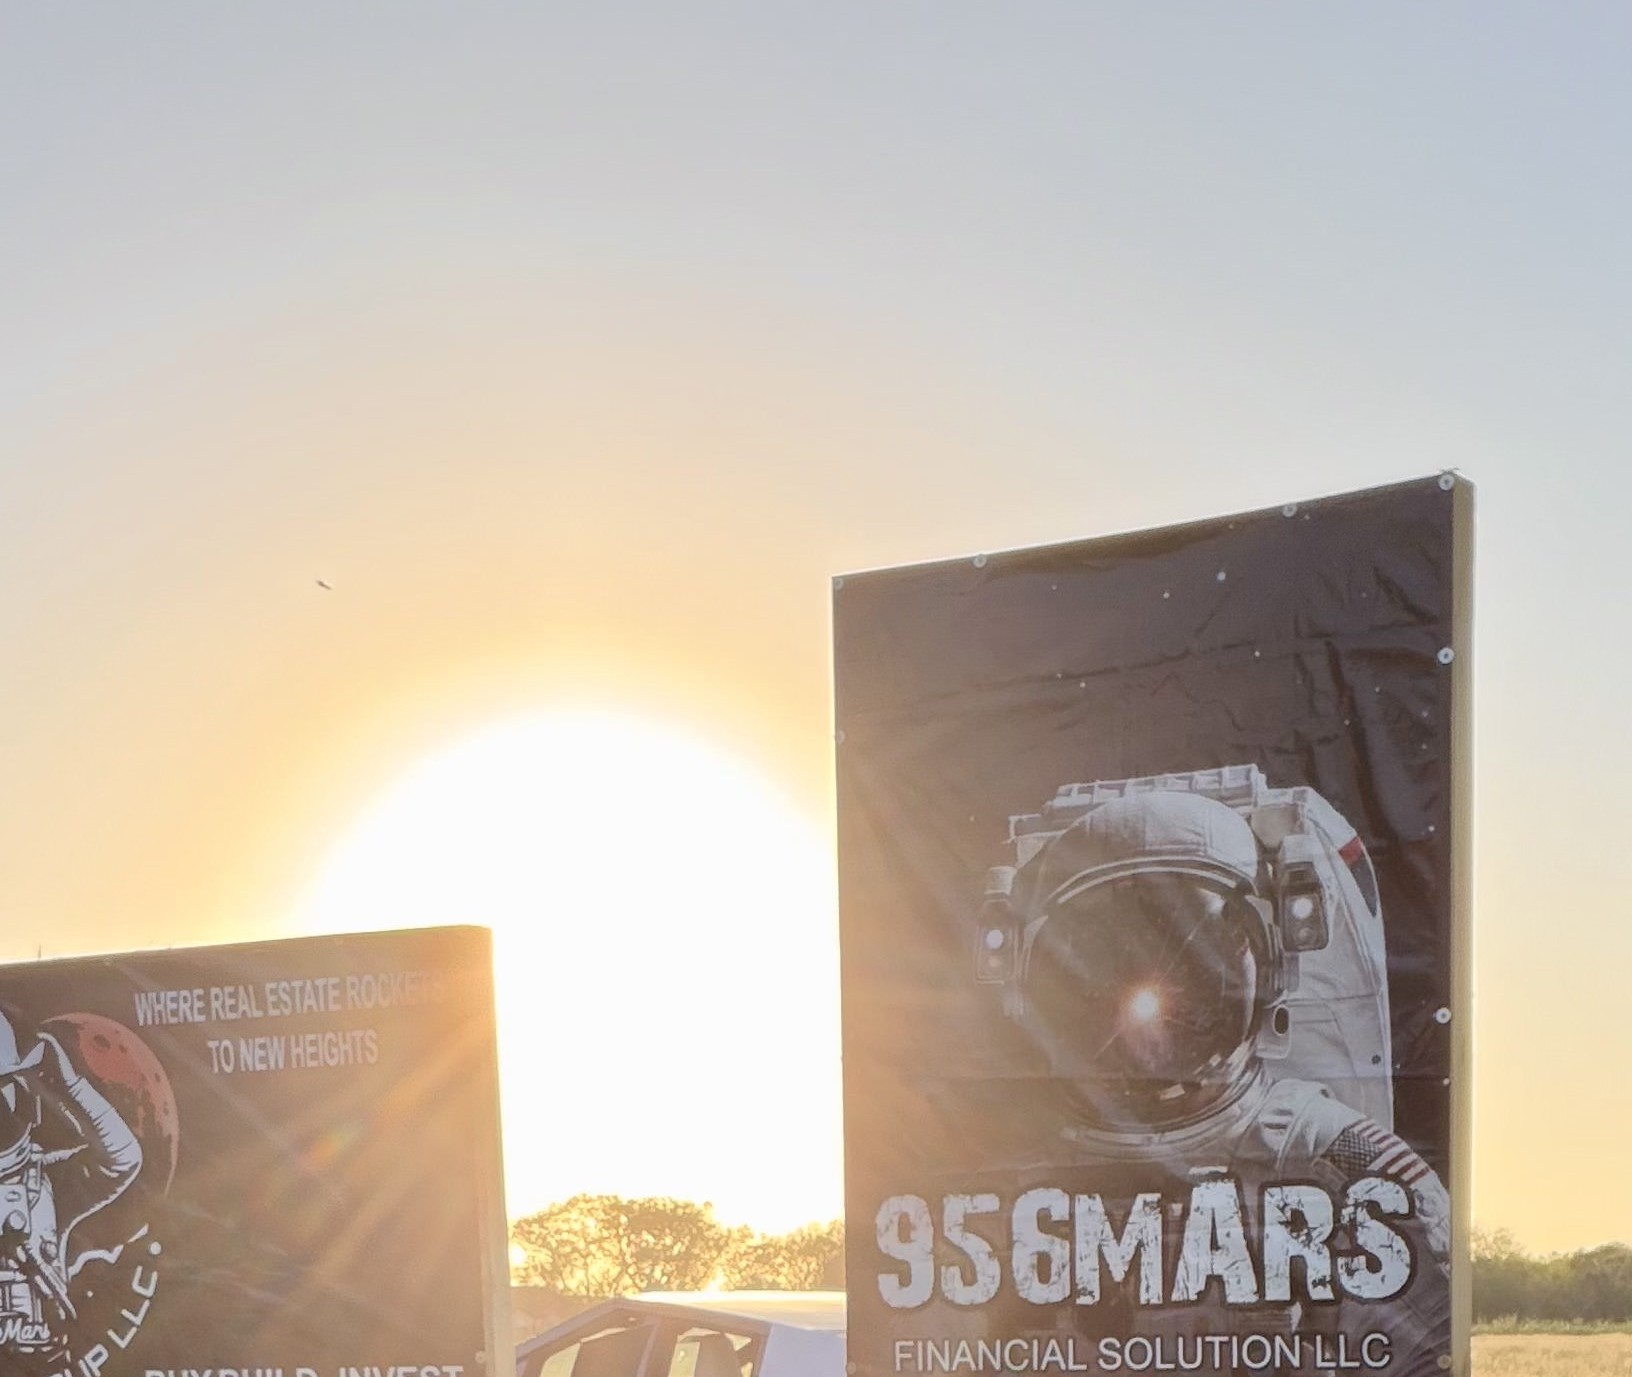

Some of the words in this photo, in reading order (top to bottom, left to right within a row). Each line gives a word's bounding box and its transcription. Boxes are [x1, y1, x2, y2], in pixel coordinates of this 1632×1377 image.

[134, 987, 207, 1027] WHERE
[210, 984, 264, 1021] REAL
[265, 976, 343, 1017] ESTATE
[207, 1038, 236, 1074] TO
[239, 1035, 286, 1072] NEW
[288, 1029, 380, 1068] HEIGHTS
[875, 1178, 1412, 1308] 956MARS
[108, 1265, 158, 1349] LLC
[894, 1339, 1090, 1371] FINANCIAL
[1098, 1336, 1301, 1371] SOLUTION
[1313, 1334, 1391, 1369] LLC
